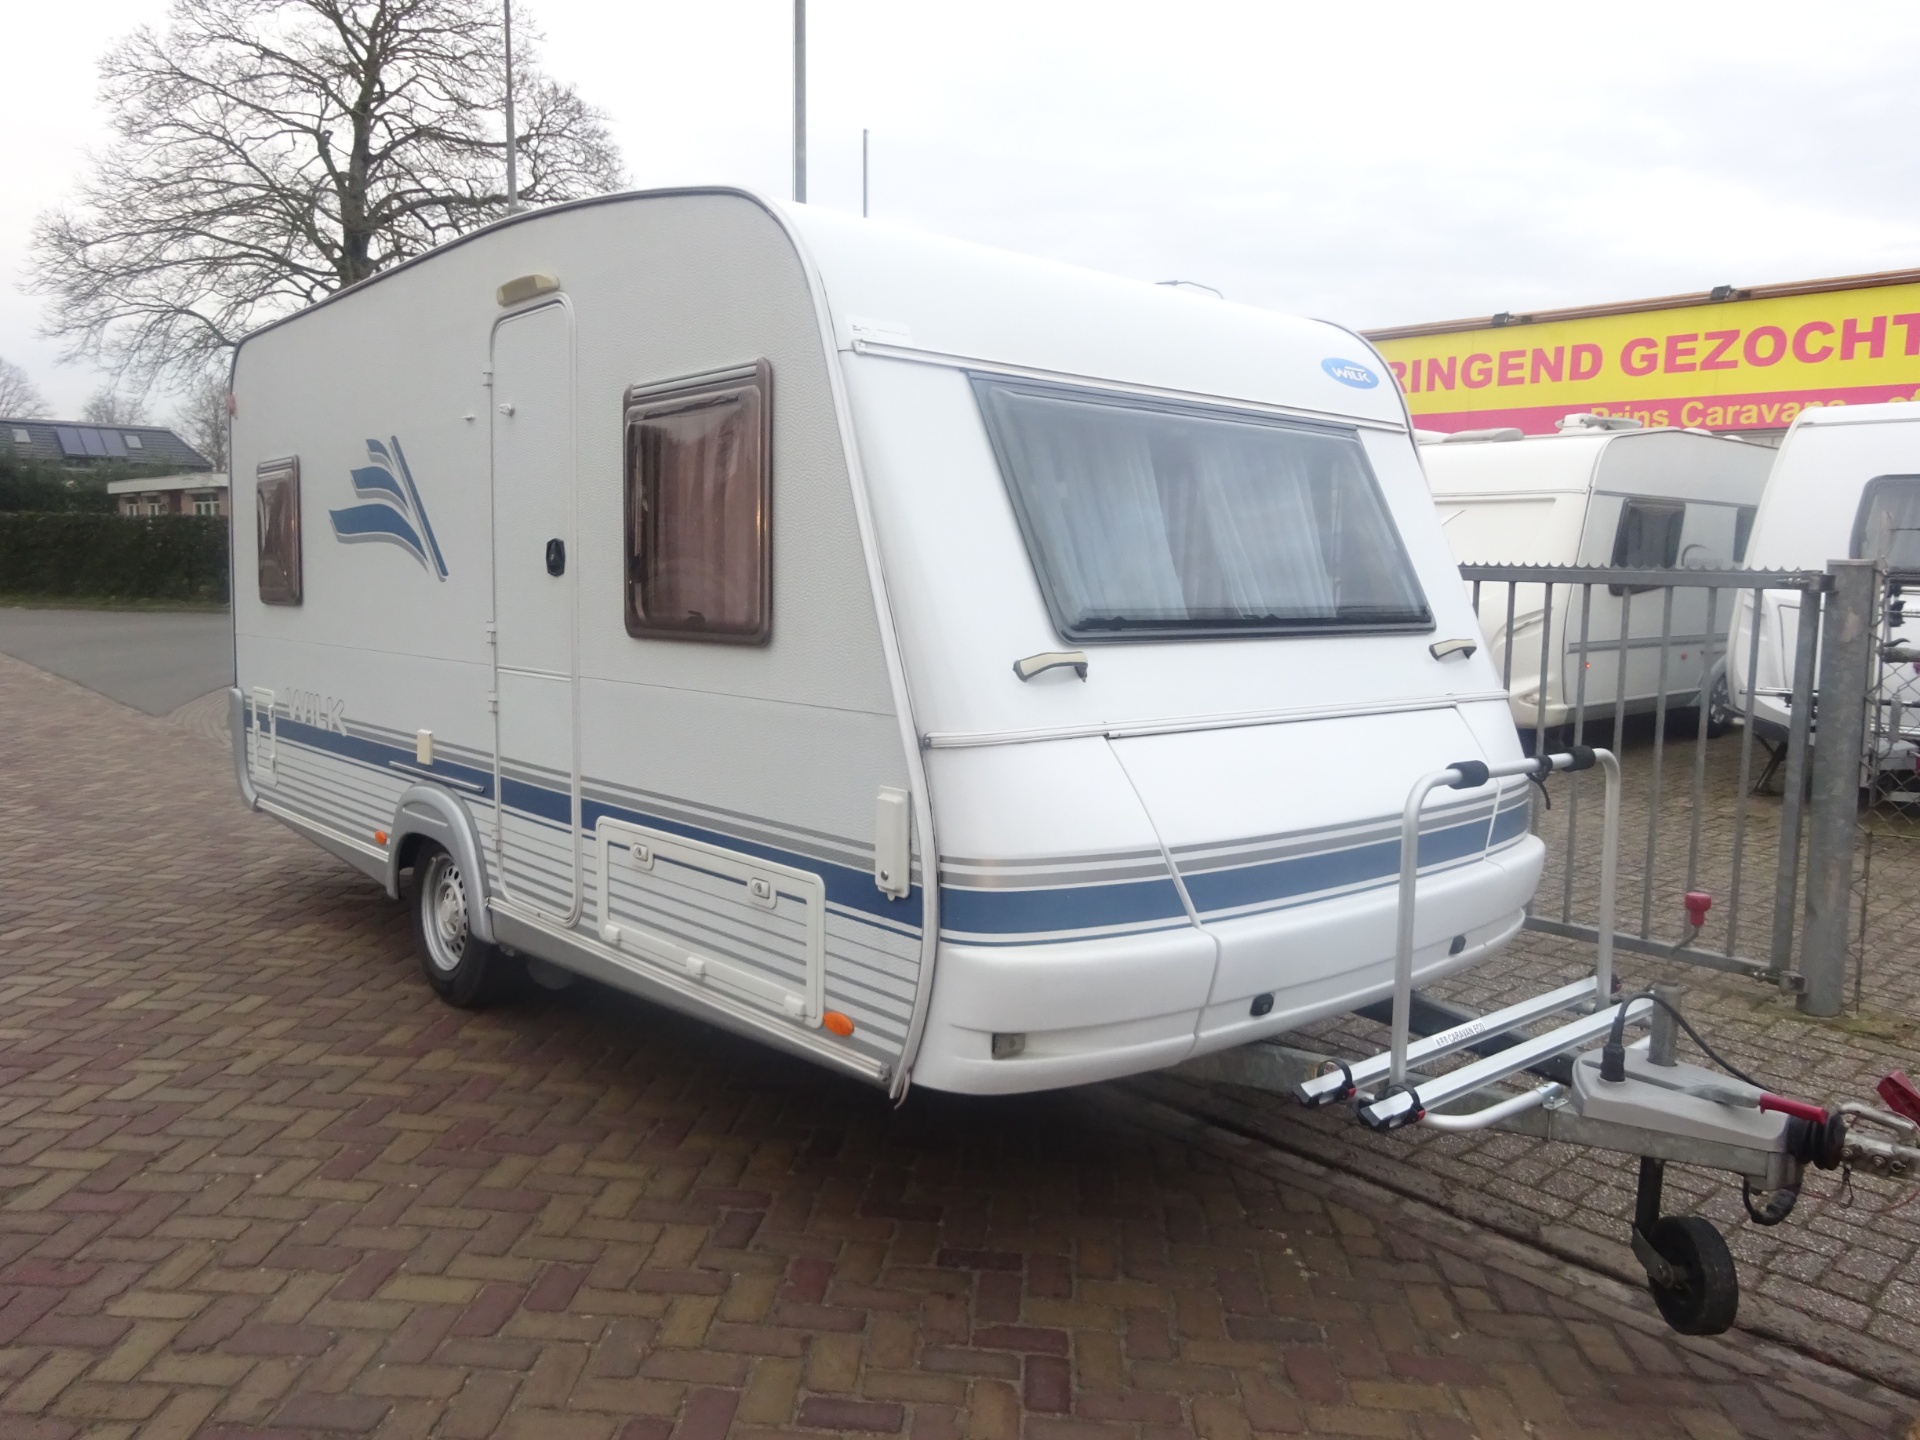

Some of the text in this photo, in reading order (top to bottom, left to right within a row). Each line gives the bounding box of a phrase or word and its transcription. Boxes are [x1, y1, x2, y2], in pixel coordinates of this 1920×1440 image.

[1619, 313, 1920, 377] GEZOCHT
[1330, 365, 1372, 384] WILK
[1680, 399, 1847, 428] Carava
[285, 687, 348, 738] WILK
